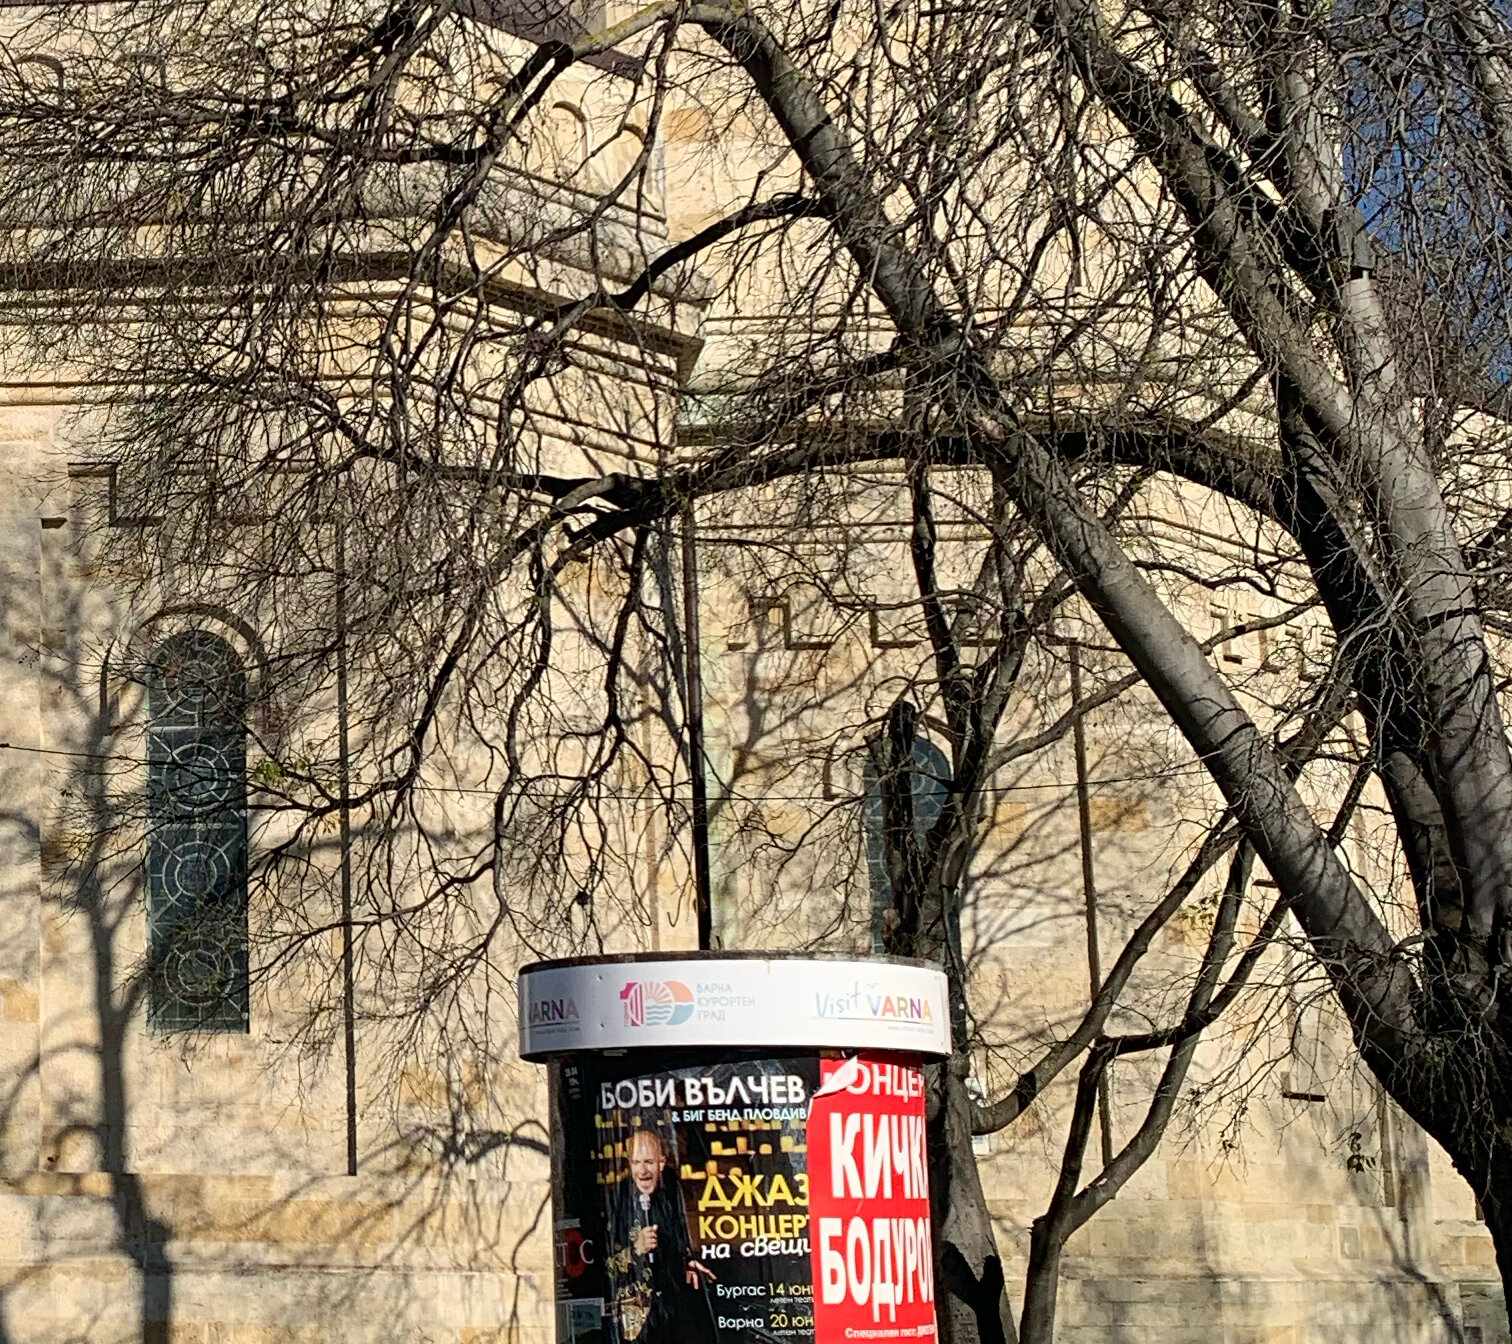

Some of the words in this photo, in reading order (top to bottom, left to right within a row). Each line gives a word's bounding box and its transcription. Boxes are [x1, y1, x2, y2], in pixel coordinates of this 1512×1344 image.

[696, 983, 732, 994] ВАРНА
[696, 996, 755, 1008] КУРОРТЕН
[816, 981, 862, 1017] Visit
[866, 995, 933, 1021] VARNA
[697, 1011, 726, 1023] ГРАД
[600, 1079, 676, 1109] БОБИ
[684, 1075, 806, 1106] ВЪЛЧЕВ
[683, 1110, 706, 1123] БИГ
[708, 1110, 742, 1123] БЕНД
[744, 1108, 807, 1121] ПЛОВДИВ
[830, 1112, 928, 1199] КИЧК
[699, 1214, 810, 1241] КОНЦЕР
[701, 1243, 730, 1259] на
[716, 1284, 766, 1299] Бургас
[769, 1283, 785, 1296] 14
[718, 1316, 764, 1330] Варна
[771, 1314, 788, 1327] 20
